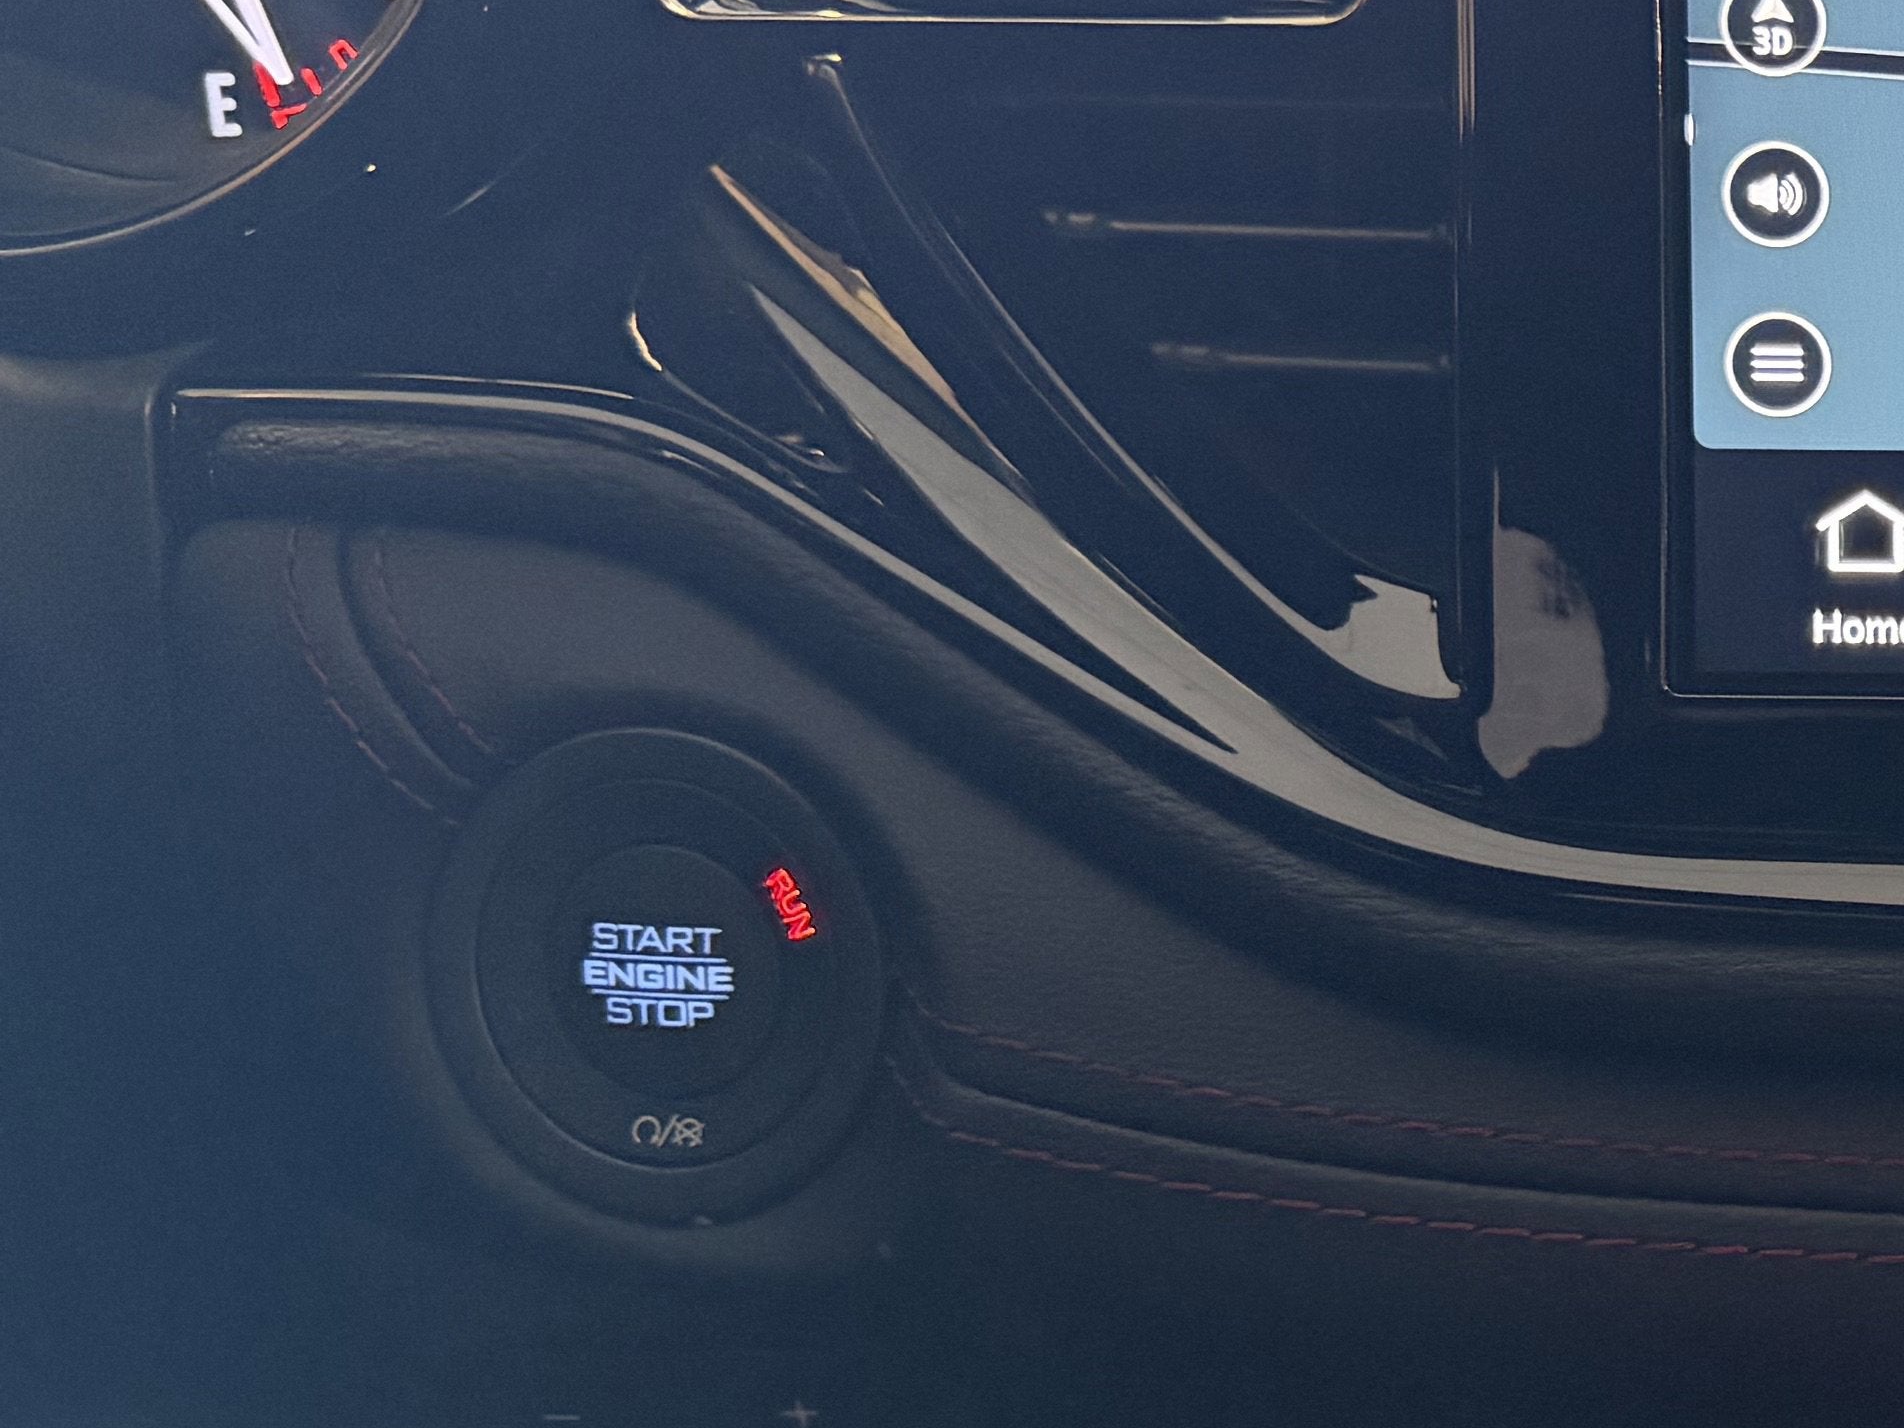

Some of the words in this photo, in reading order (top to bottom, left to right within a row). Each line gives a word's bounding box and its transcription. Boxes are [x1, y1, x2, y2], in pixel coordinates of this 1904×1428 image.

[1750, 26, 1795, 57] 3D
[205, 70, 245, 139] E
[762, 866, 818, 943] RUN
[591, 922, 724, 956] START
[582, 958, 735, 993] ENGINE
[605, 996, 716, 1029] STOP
